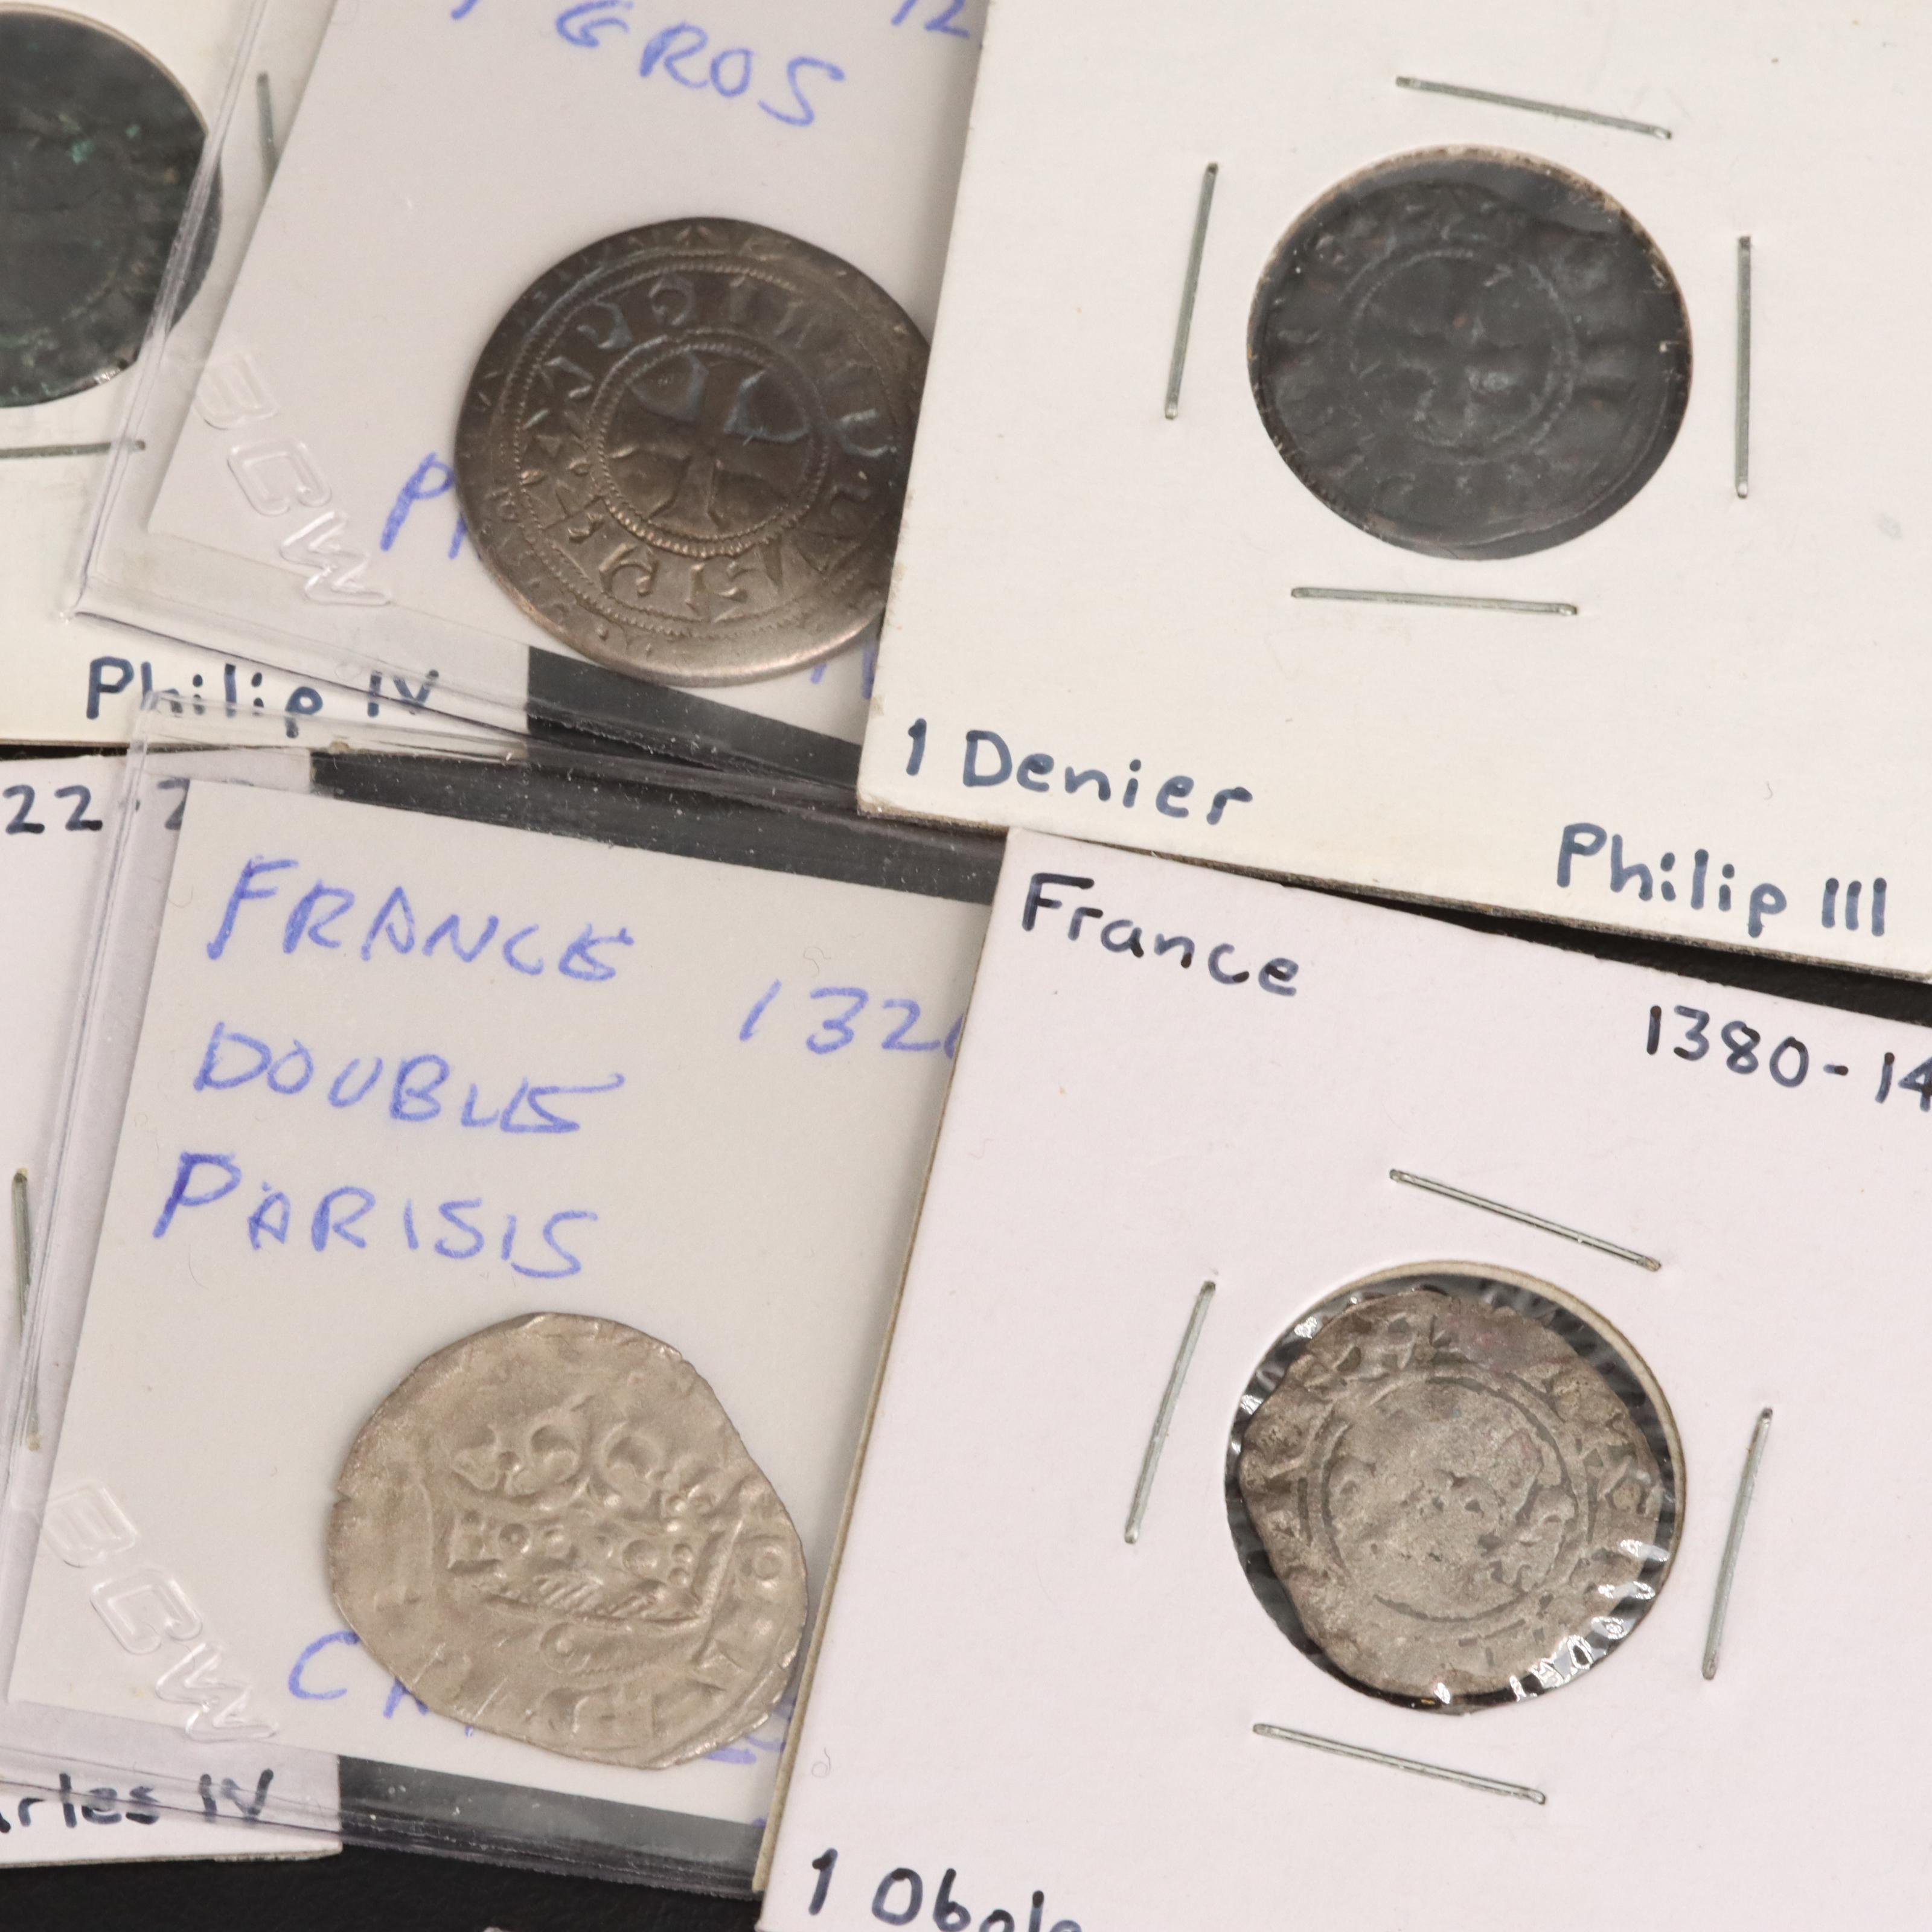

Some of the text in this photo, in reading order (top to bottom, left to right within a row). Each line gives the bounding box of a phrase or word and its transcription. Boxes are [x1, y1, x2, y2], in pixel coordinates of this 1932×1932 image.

[555, 0, 845, 127] GROS
[86, 656, 440, 738] Philip IV
[907, 718, 1253, 825] 1 Denier
[206, 856, 635, 982] FRANCE
[1022, 872, 1300, 997] France
[1556, 822, 1887, 938] Philip III
[193, 1022, 625, 1134] DOUBLE
[153, 1151, 598, 1279] PARISIS
[0, 1768, 274, 1834] rles IV
[808, 1847, 838, 1916] 1
